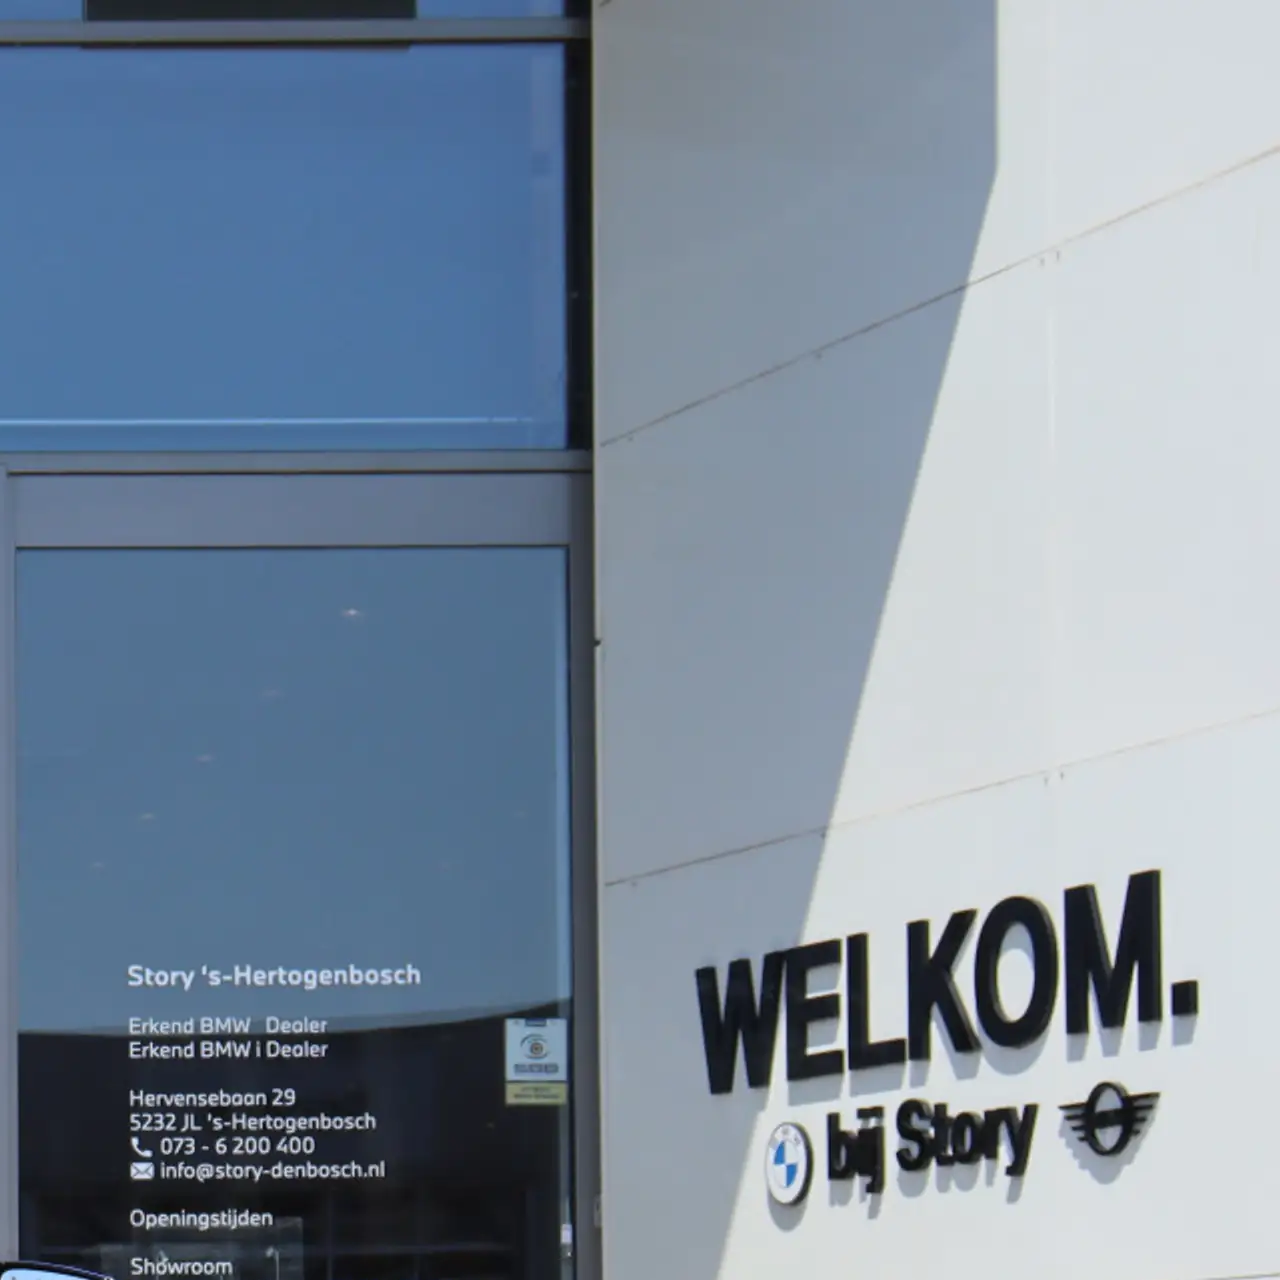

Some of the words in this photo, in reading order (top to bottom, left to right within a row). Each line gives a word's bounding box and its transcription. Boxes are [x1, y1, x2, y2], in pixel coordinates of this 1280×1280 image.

[128, 965, 194, 990] Story
[202, 964, 420, 989] 's-Hertogenbosch
[694, 868, 1199, 1094] WELKOM.
[129, 1018, 195, 1034] Erkend
[201, 1018, 251, 1034] BMW
[266, 1018, 328, 1034] Dealer
[130, 1042, 194, 1058] Erkend
[201, 1041, 251, 1058] BMW
[267, 1041, 328, 1057] Dealer
[130, 1089, 266, 1106] Hervensebaan
[272, 1088, 295, 1105] 29
[131, 1114, 176, 1131] 5232
[181, 1114, 202, 1131] JL
[208, 1113, 376, 1133] 's-Hertogenbosch
[161, 1137, 195, 1154] 073
[216, 1138, 227, 1154] 6
[233, 1136, 270, 1154] 200
[276, 1136, 314, 1154] 400
[827, 1106, 885, 1194] bij
[896, 1099, 1039, 1177] Story
[161, 1161, 384, 1182] info@story-denbosch.nl
[130, 1210, 274, 1230] Openingstijden
[131, 1259, 233, 1276] Showroom
